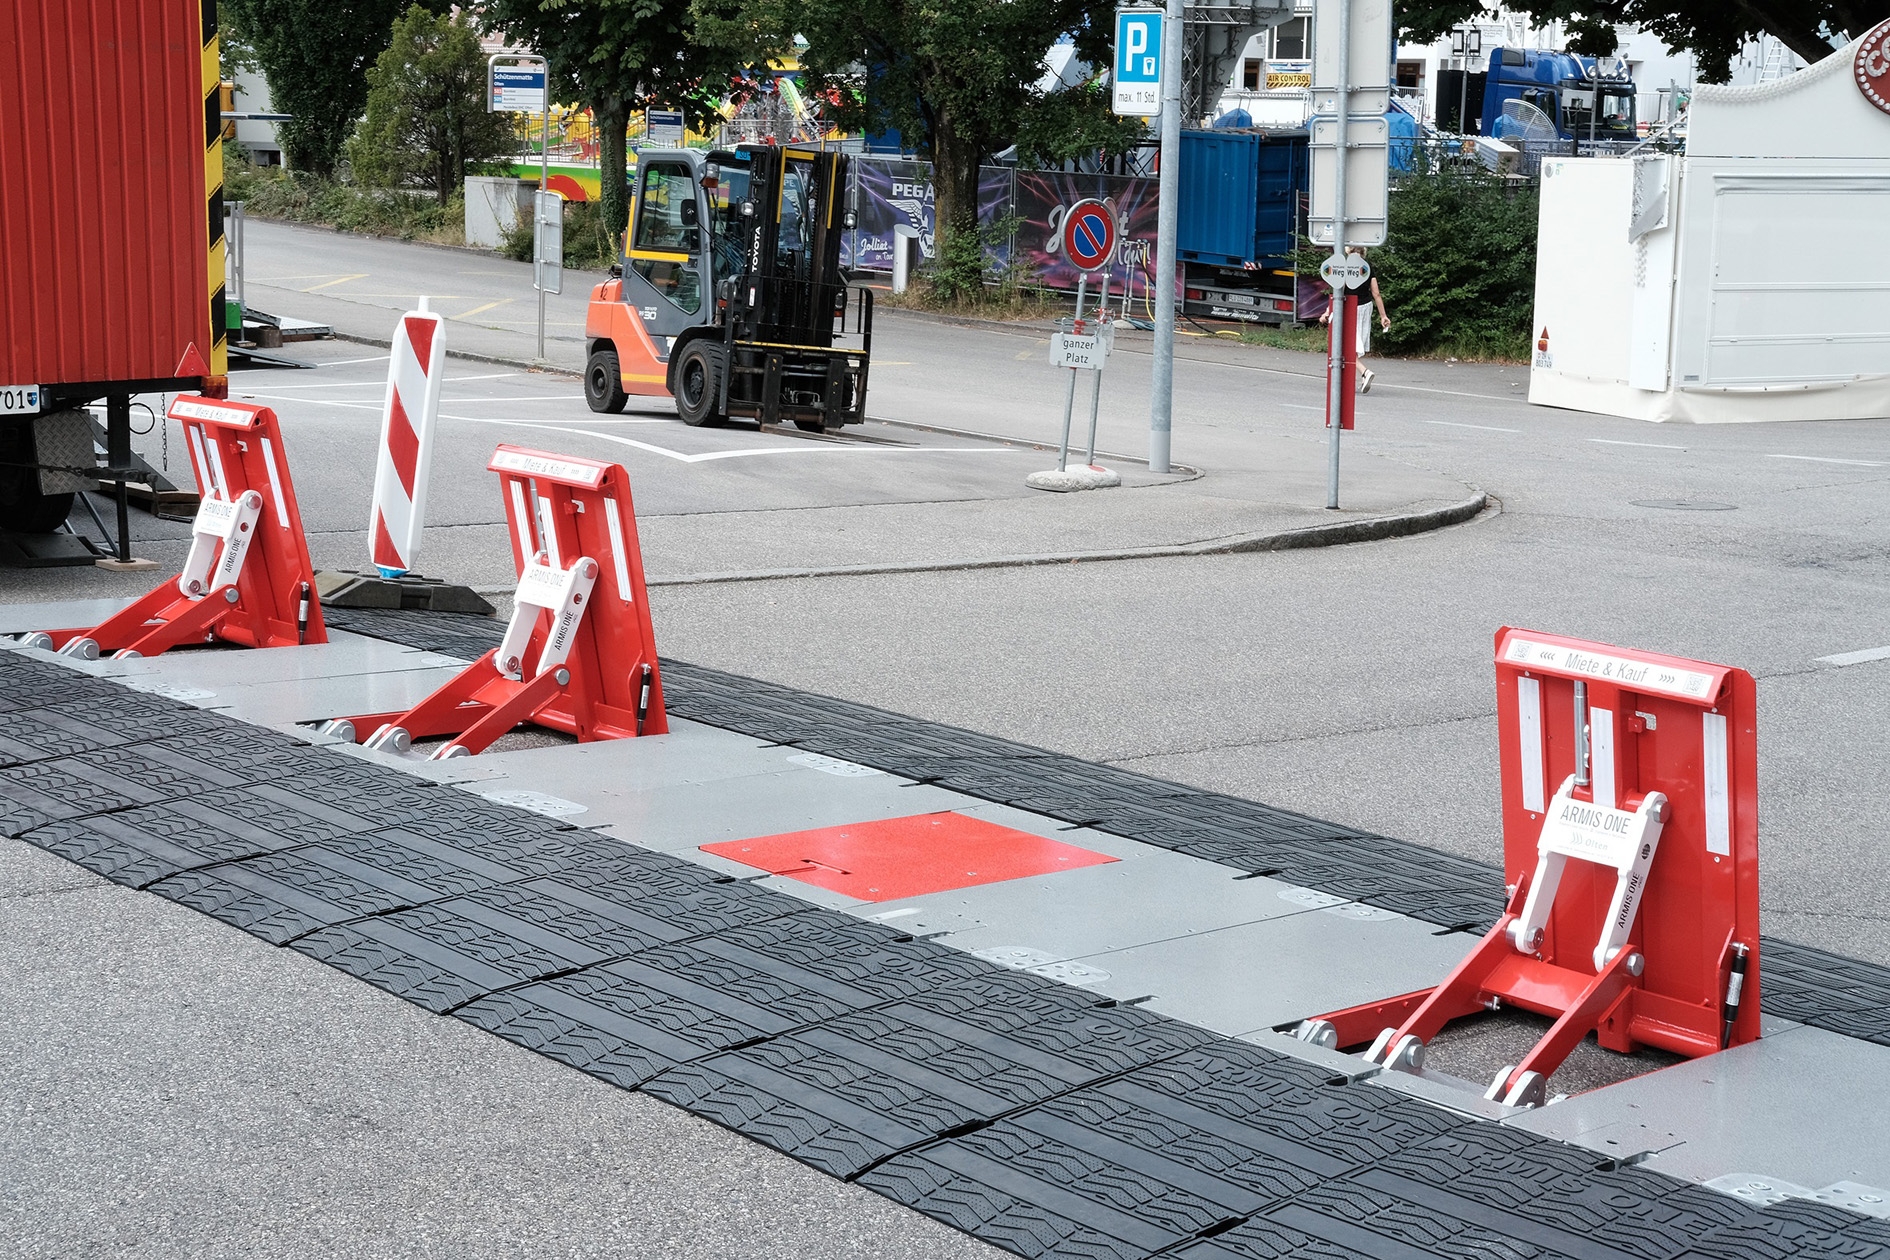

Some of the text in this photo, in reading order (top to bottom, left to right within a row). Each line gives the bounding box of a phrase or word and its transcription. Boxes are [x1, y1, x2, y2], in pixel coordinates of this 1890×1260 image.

[1125, 22, 1148, 72] P
[493, 73, 534, 81] Schützenmatte
[1118, 92, 1134, 103] max.
[1144, 91, 1157, 104] Std.
[892, 182, 935, 202] PEGA
[751, 226, 761, 273] TOYOTA
[1332, 270, 1345, 278] Weg
[1347, 270, 1360, 278] Weg
[1063, 340, 1094, 350] ganzer
[1065, 352, 1089, 364] Platz
[204, 502, 233, 517] ARMIS ONE
[225, 538, 242, 574] ARMIS ONE
[528, 568, 566, 587] ARMIS ONE
[554, 610, 575, 651] ARMIS ONE
[1565, 653, 1649, 683] Miete & Kauf
[1560, 804, 1602, 828] ARMIS
[1603, 814, 1631, 835] ONE
[537, 841, 600, 866] ONE
[1585, 838, 1609, 851] Olten
[604, 860, 771, 921] ARMIS ONE
[1617, 895, 1633, 929] ARMIS
[1629, 871, 1641, 894] ONE
[774, 920, 960, 990] ARMIS ONE
[960, 981, 1181, 1060] ARMIS ONE
[1176, 1055, 1426, 1150] ARMIS ONE
[1428, 1141, 1718, 1240] ARMIS ONE
[1728, 1217, 1890, 1260] ARM
